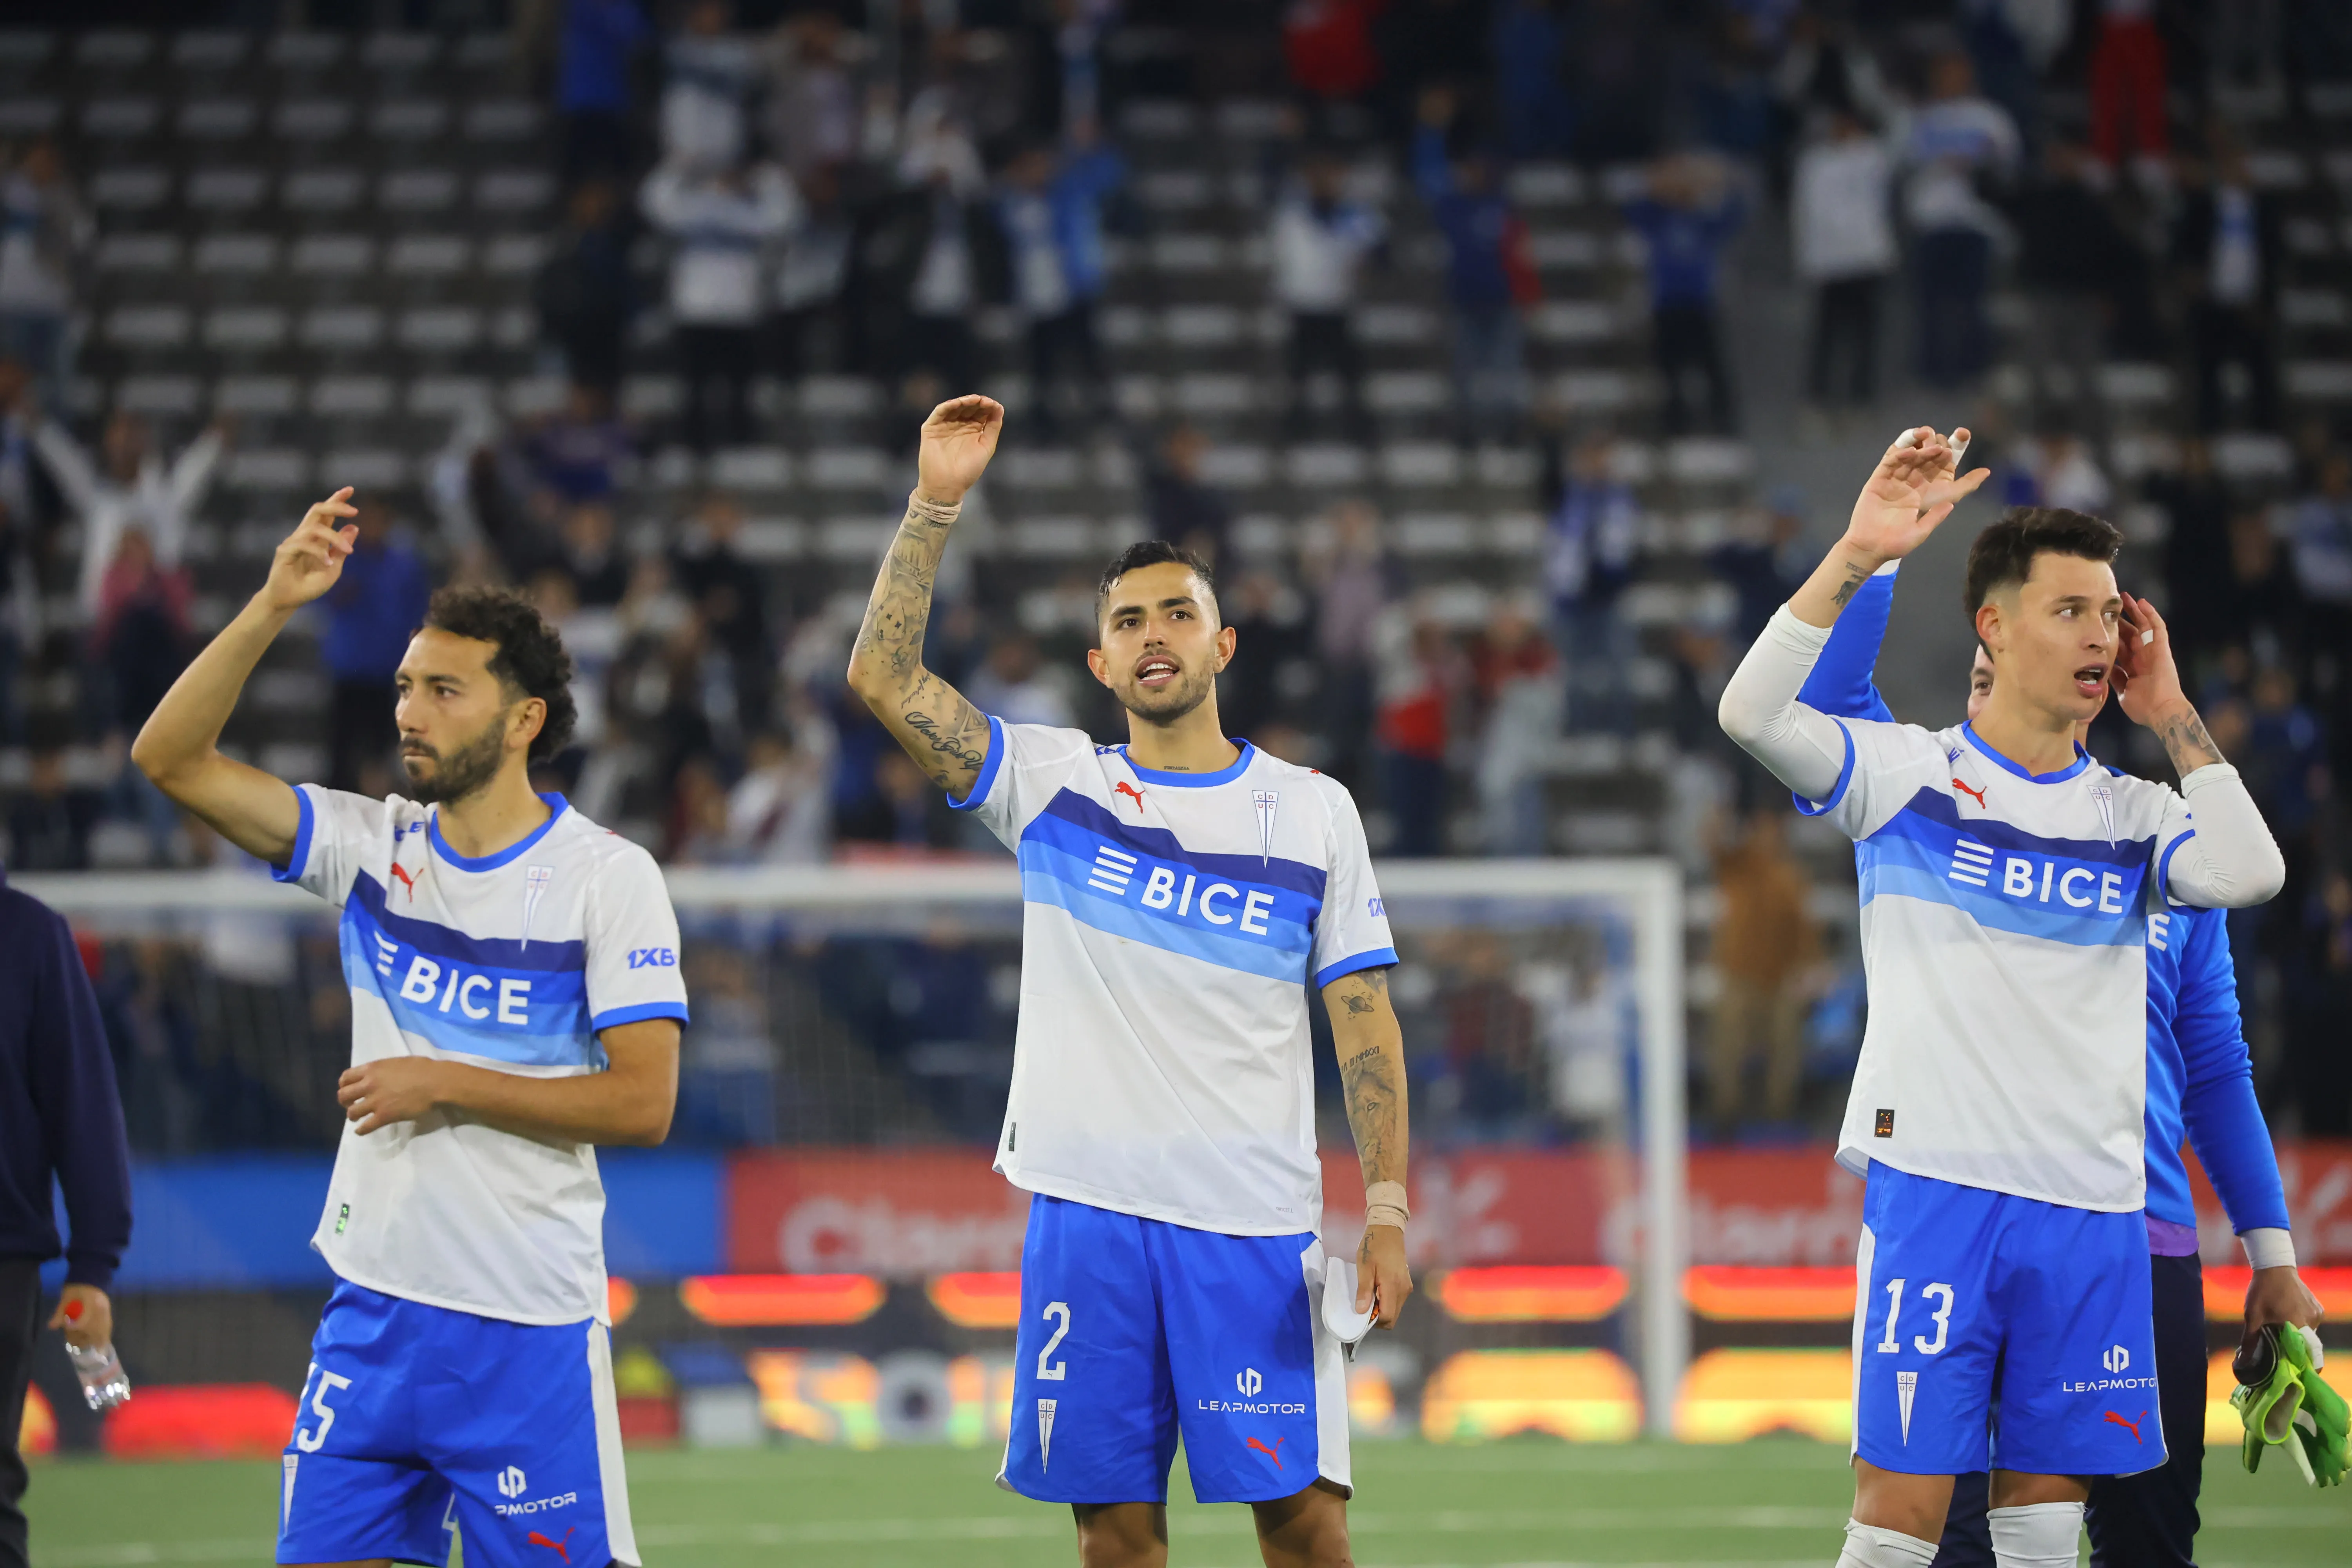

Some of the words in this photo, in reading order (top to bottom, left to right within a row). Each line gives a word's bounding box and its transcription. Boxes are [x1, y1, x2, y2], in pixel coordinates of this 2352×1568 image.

[1140, 866, 1274, 936] BICE
[2003, 857, 2122, 914] BICE
[628, 947, 678, 969] 1XB
[399, 955, 531, 1025] BICE
[1036, 1301, 1071, 1381] 2
[1877, 1278, 1955, 1355] 13
[1198, 1399, 1305, 1414] LEAPMOTOR
[2063, 1377, 2156, 1392] LEAPMOTO
